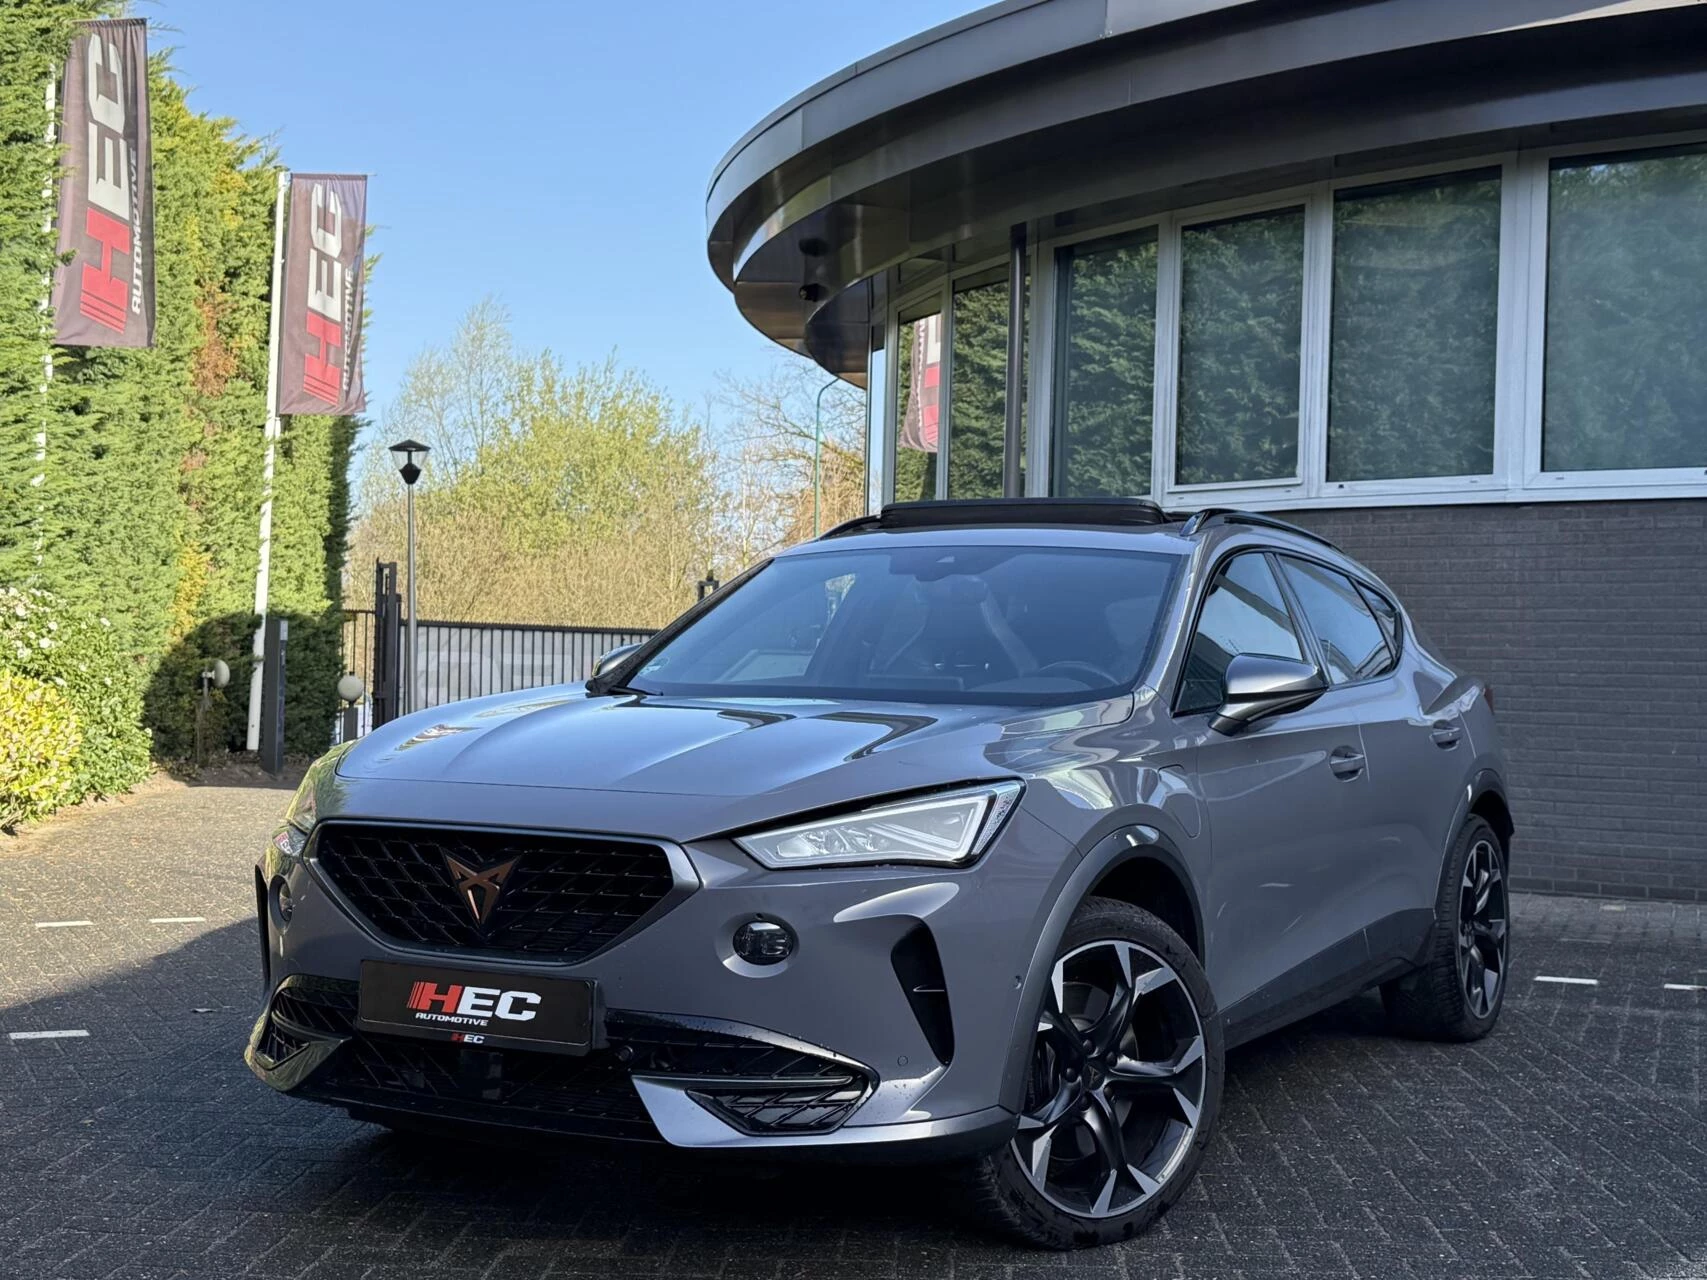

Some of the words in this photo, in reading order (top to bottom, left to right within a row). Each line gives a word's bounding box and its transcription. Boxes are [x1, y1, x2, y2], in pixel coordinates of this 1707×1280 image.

[80, 33, 129, 334] HEC
[130, 149, 142, 314] AUTOMOTIVE
[303, 183, 342, 406] HEC
[406, 981, 542, 1021] HEC
[415, 1012, 488, 1026] AUTOMOTIVE
[451, 1032, 485, 1044] HEC
